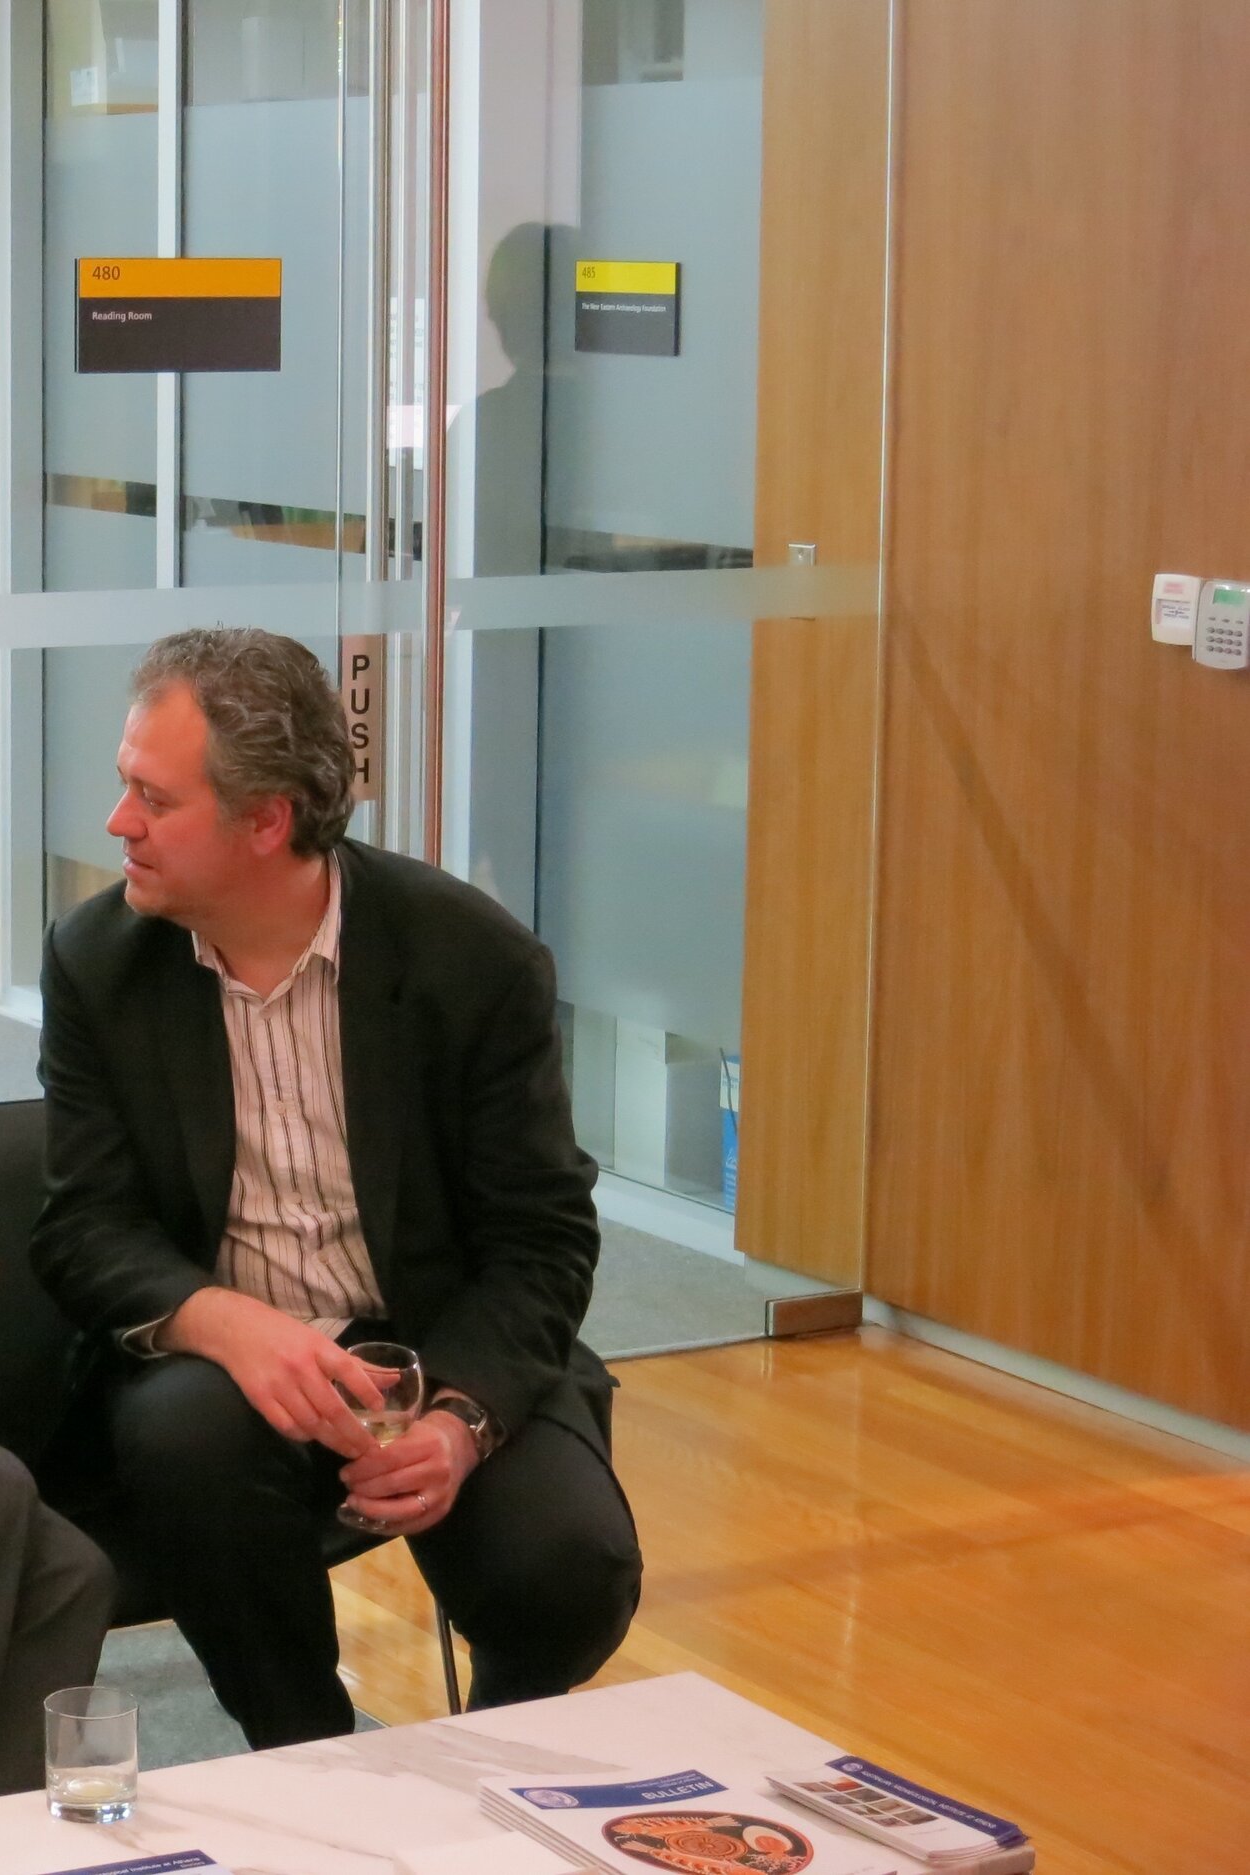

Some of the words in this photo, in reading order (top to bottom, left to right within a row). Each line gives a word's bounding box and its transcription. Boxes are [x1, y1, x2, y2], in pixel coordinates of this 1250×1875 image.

[92, 265, 121, 281] 480
[582, 266, 596, 279] 485
[92, 312, 126, 323] Reading
[128, 312, 152, 320] Room
[351, 655, 370, 783] PUSH
[641, 1781, 714, 1800] BULLETIN
